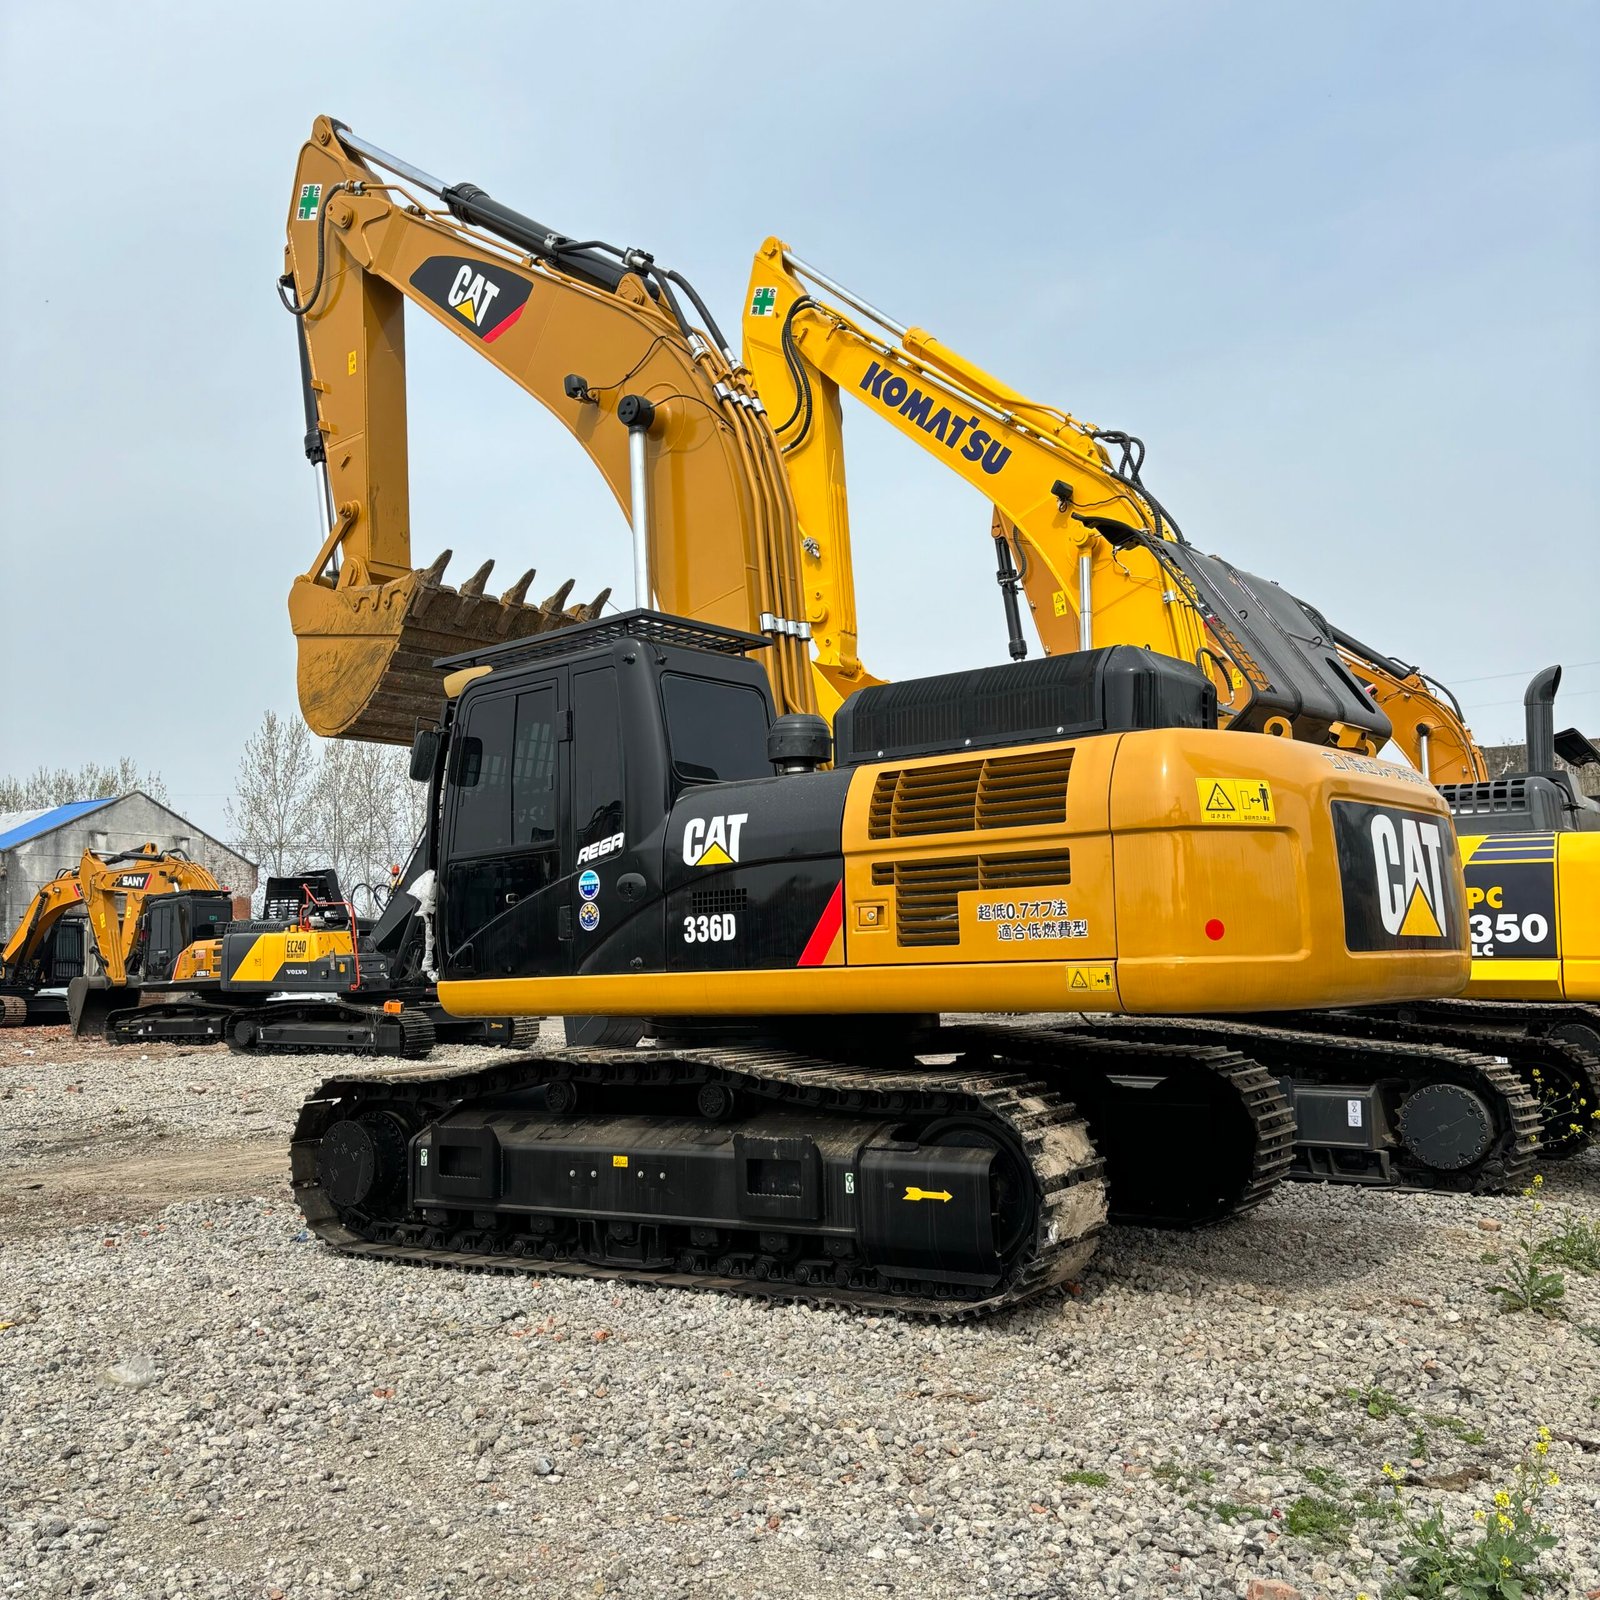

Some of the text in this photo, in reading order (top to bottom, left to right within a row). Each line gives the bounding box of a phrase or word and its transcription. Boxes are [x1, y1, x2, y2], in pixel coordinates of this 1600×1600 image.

[448, 264, 500, 327] CAT
[859, 361, 1012, 474] KOMATSU
[577, 832, 625, 866] REGA
[682, 813, 748, 867] CAT
[122, 876, 144, 887] SANY
[1371, 814, 1447, 937] CAT
[1465, 886, 1503, 910] PC
[683, 913, 736, 943] 336D
[998, 920, 1088, 941] 適合低燃費型
[1469, 913, 1549, 943] 350
[286, 940, 307, 953] EC240
[1472, 943, 1494, 957] LC
